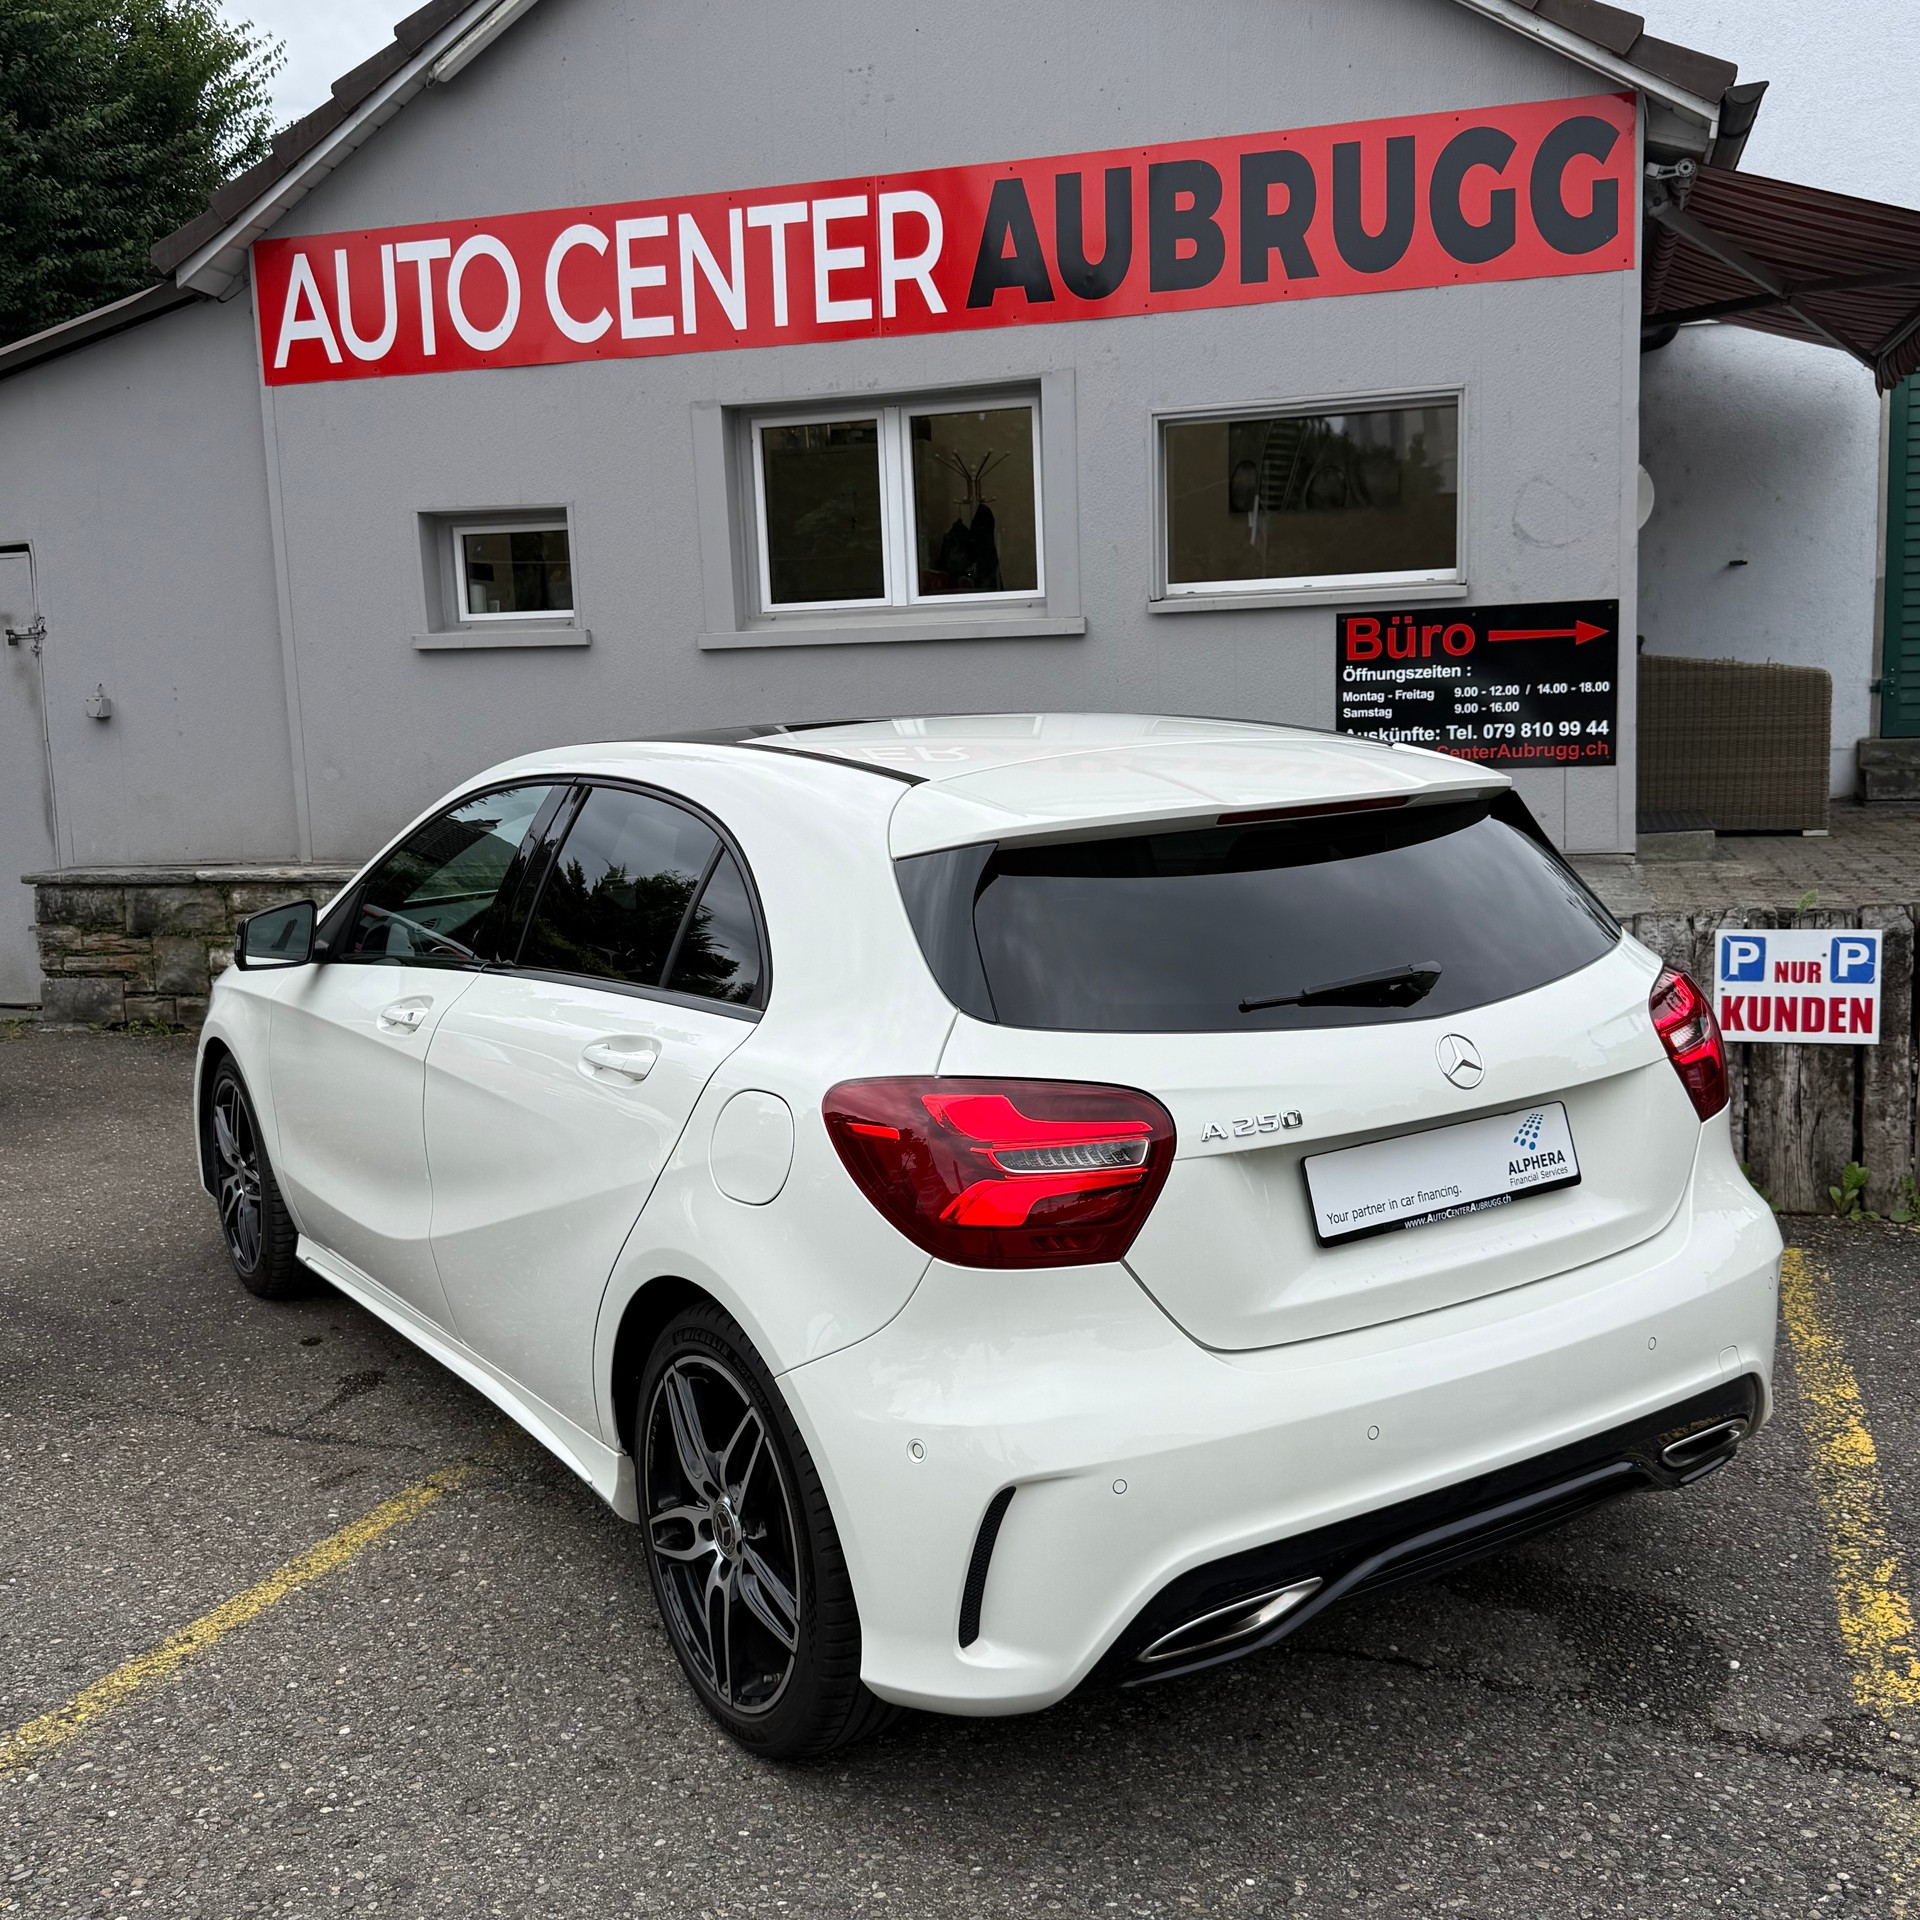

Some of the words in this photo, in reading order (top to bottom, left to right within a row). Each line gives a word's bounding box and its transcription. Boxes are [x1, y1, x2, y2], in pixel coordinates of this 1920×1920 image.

[274, 234, 521, 369] AUTO
[545, 190, 947, 344] CENTER
[965, 116, 1621, 310] AUBRUGG
[1346, 616, 1476, 661] Büro
[1342, 665, 1462, 683] Öffnungszeiten
[1342, 691, 1385, 703] Montag
[1395, 689, 1435, 701] Freitag
[1453, 686, 1479, 698] 9.00
[1489, 684, 1520, 696] 12.00
[1537, 682, 1568, 694] 14.00
[1578, 681, 1610, 693] 18.00
[1342, 707, 1393, 719] Samstag
[1453, 702, 1479, 714] 9.00
[1489, 701, 1520, 713] 16.00
[1446, 724, 1478, 740] Tel.
[1482, 723, 1516, 739] 079
[1520, 721, 1554, 738] 810
[1558, 720, 1581, 737] 99
[1586, 719, 1610, 736] 44
[1774, 961, 1822, 984] NUR
[1720, 995, 1874, 1034] KUNDEN
[1201, 1121, 1229, 1142] A
[1232, 1109, 1304, 1138] 250
[1508, 1149, 1566, 1176] ALPHERA
[1509, 1170, 1539, 1187] Financial
[1540, 1164, 1569, 1179] Services
[1326, 1210, 1350, 1225] Your
[1352, 1201, 1387, 1222] partner
[1388, 1198, 1399, 1211] in
[1400, 1195, 1415, 1208] car
[1417, 1184, 1463, 1204] financing.
[682, 1327, 731, 1357] MICHELIN
